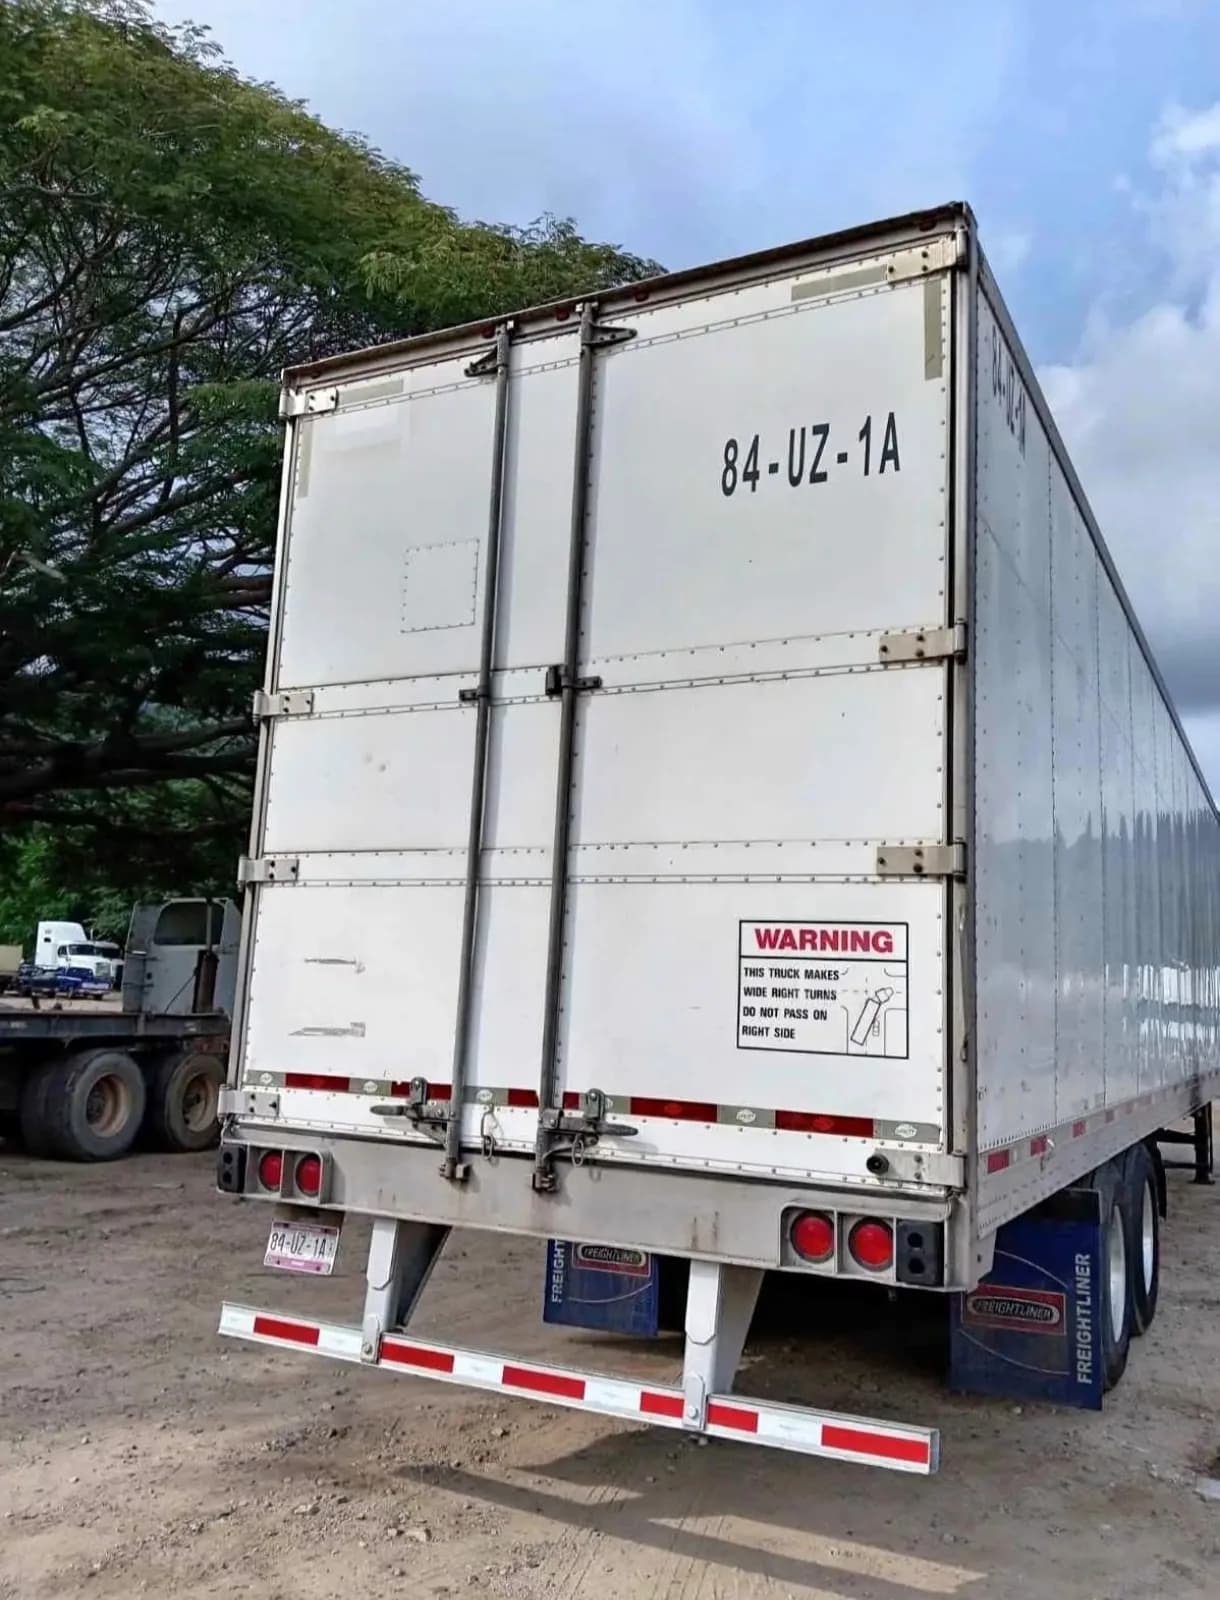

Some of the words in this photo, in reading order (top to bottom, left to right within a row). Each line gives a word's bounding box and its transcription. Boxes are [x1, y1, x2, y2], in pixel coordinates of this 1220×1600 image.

[721, 411, 900, 497] 84-UZ-1A
[754, 928, 894, 953] WARNING
[743, 967, 765, 978] THIS
[769, 968, 800, 979] TRUCK
[804, 969, 840, 981] MAKES
[743, 987, 768, 998] WIDE
[771, 987, 800, 999] RIGHT
[804, 989, 838, 1001] TURNS
[742, 1006, 756, 1017] DO
[759, 1007, 780, 1018] NOT
[783, 1008, 809, 1020] PASS
[813, 1009, 828, 1021] ON
[741, 1025, 770, 1037] RIGHT
[774, 1027, 796, 1039] SIDE
[270, 1231, 327, 1258] 84-UZ-1A
[975, 1301, 1051, 1321] FREIGHTLINER
[1075, 1253, 1093, 1384] FREIGHTLINER
